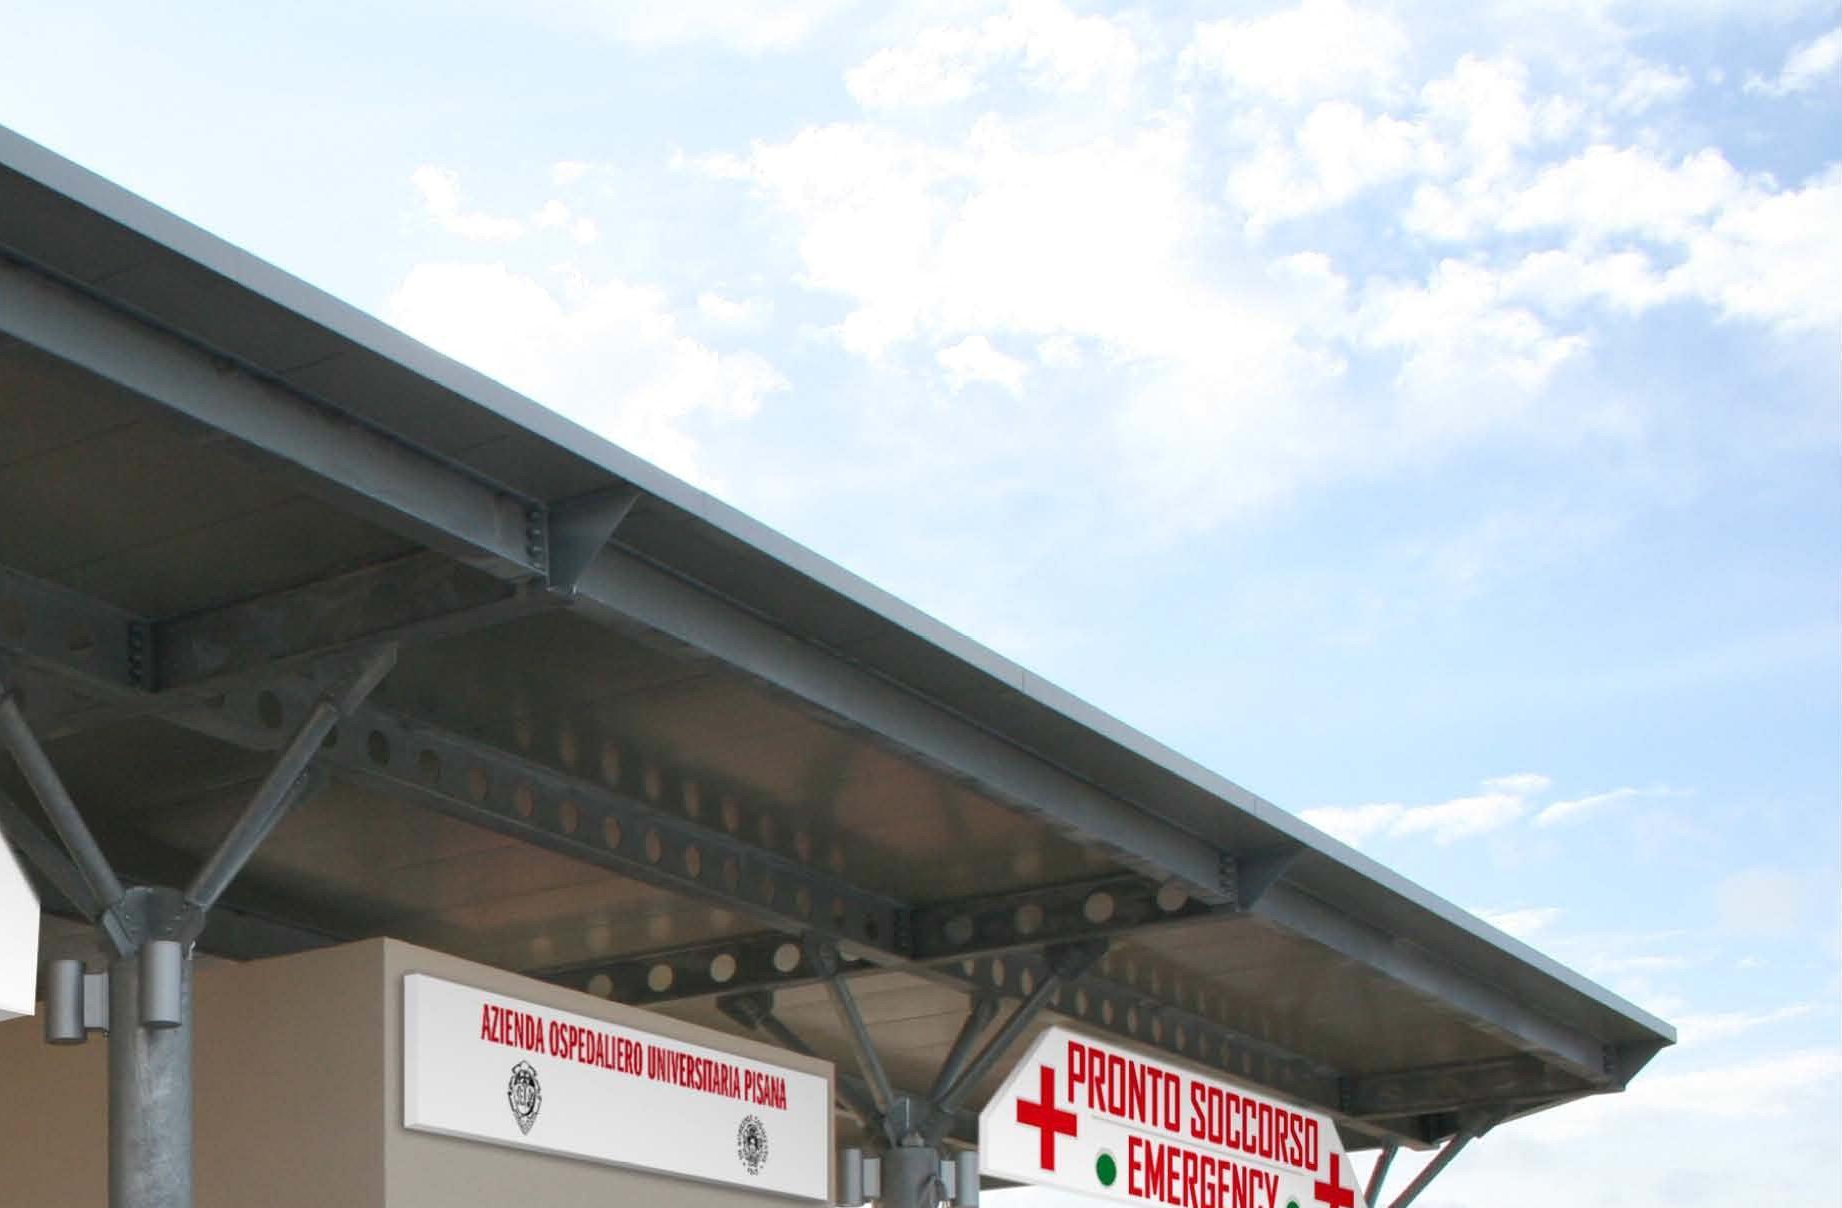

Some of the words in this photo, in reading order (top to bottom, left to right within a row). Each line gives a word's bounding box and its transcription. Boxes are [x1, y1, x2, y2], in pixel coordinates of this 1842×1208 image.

[481, 1003, 546, 1054] AZIENDA
[549, 1020, 644, 1077] OSPEDALIERO
[647, 1045, 742, 1100] UNIVERSITARIA
[743, 1068, 788, 1111] PISANA
[1067, 1039, 1182, 1134] PRONTO
[1189, 1080, 1320, 1173] SOCCORSO
